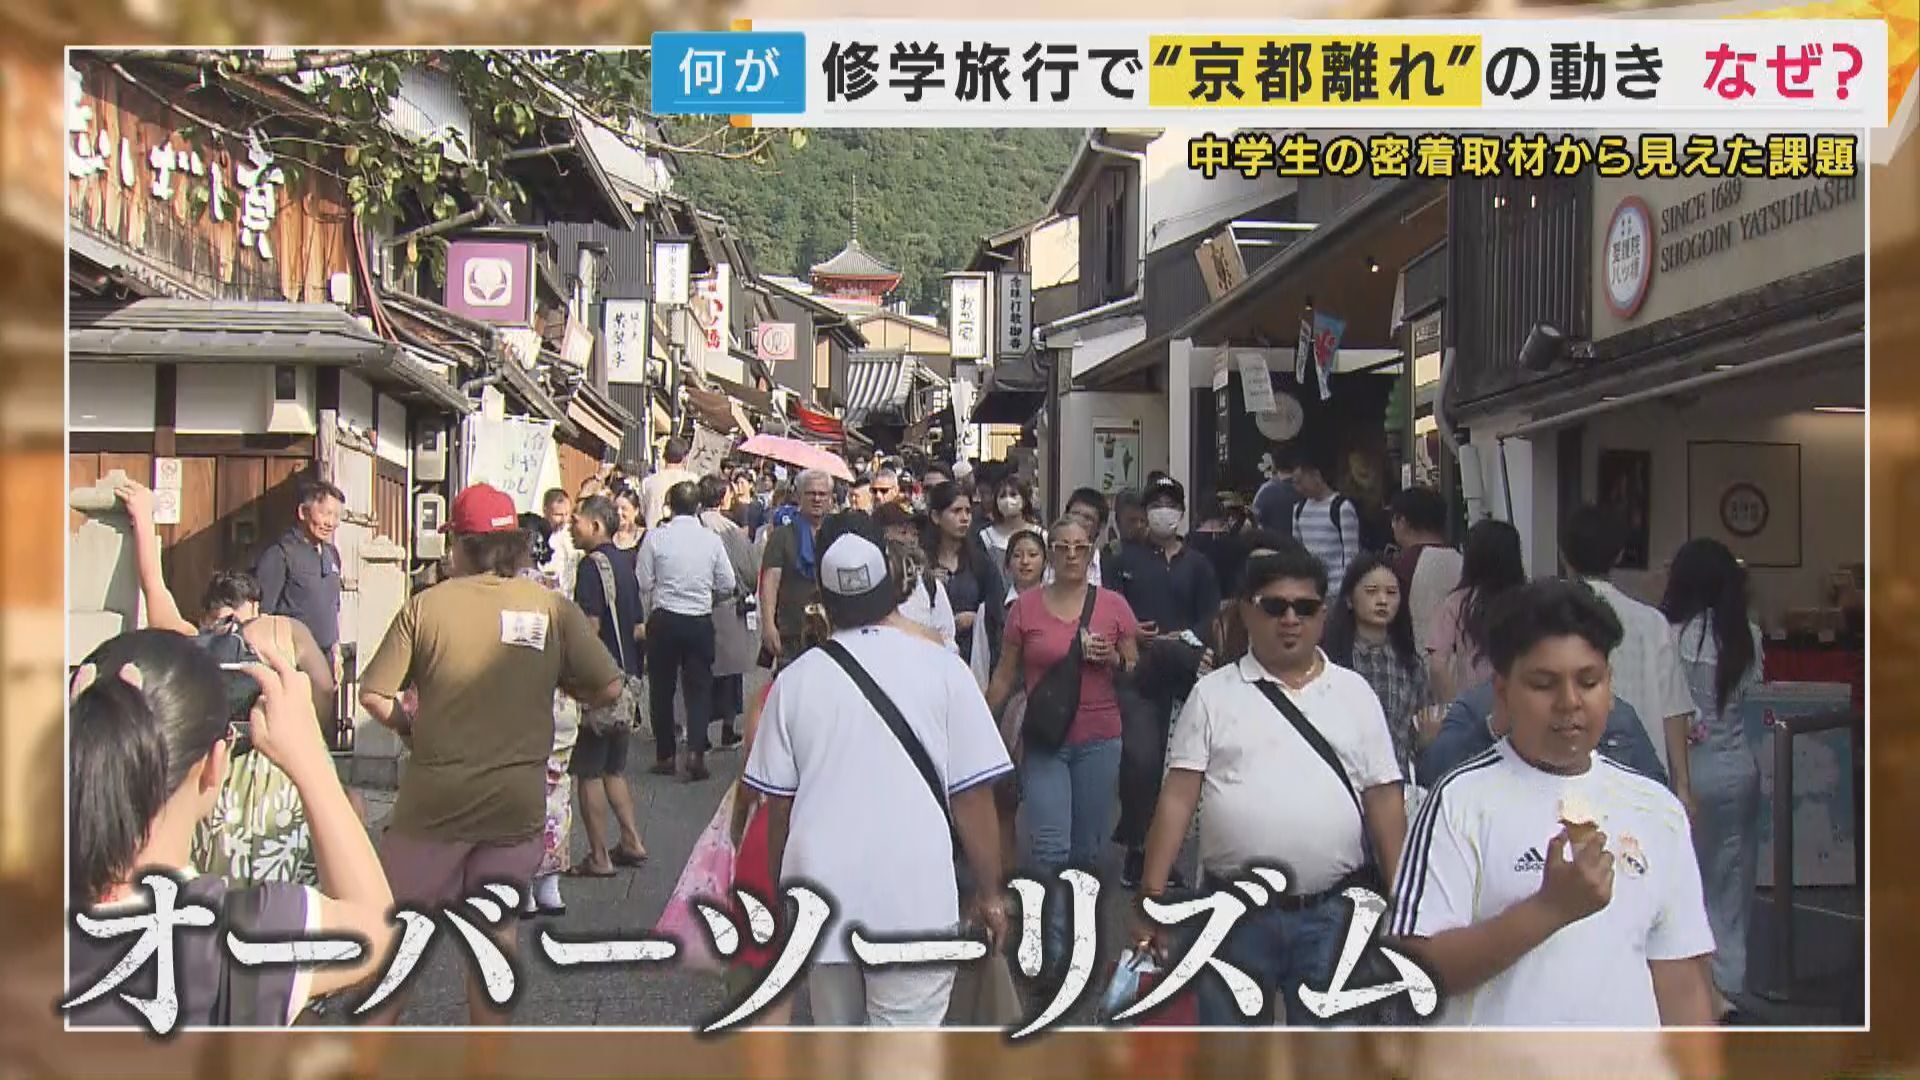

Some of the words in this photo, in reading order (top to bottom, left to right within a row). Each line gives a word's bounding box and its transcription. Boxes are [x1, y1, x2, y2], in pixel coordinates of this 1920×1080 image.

[1660, 221, 1732, 273] SHOGOIN
[1738, 177, 1857, 241] YATSUHASHI
[1661, 192, 1706, 236] SINCE
[1711, 177, 1742, 214] 1689
